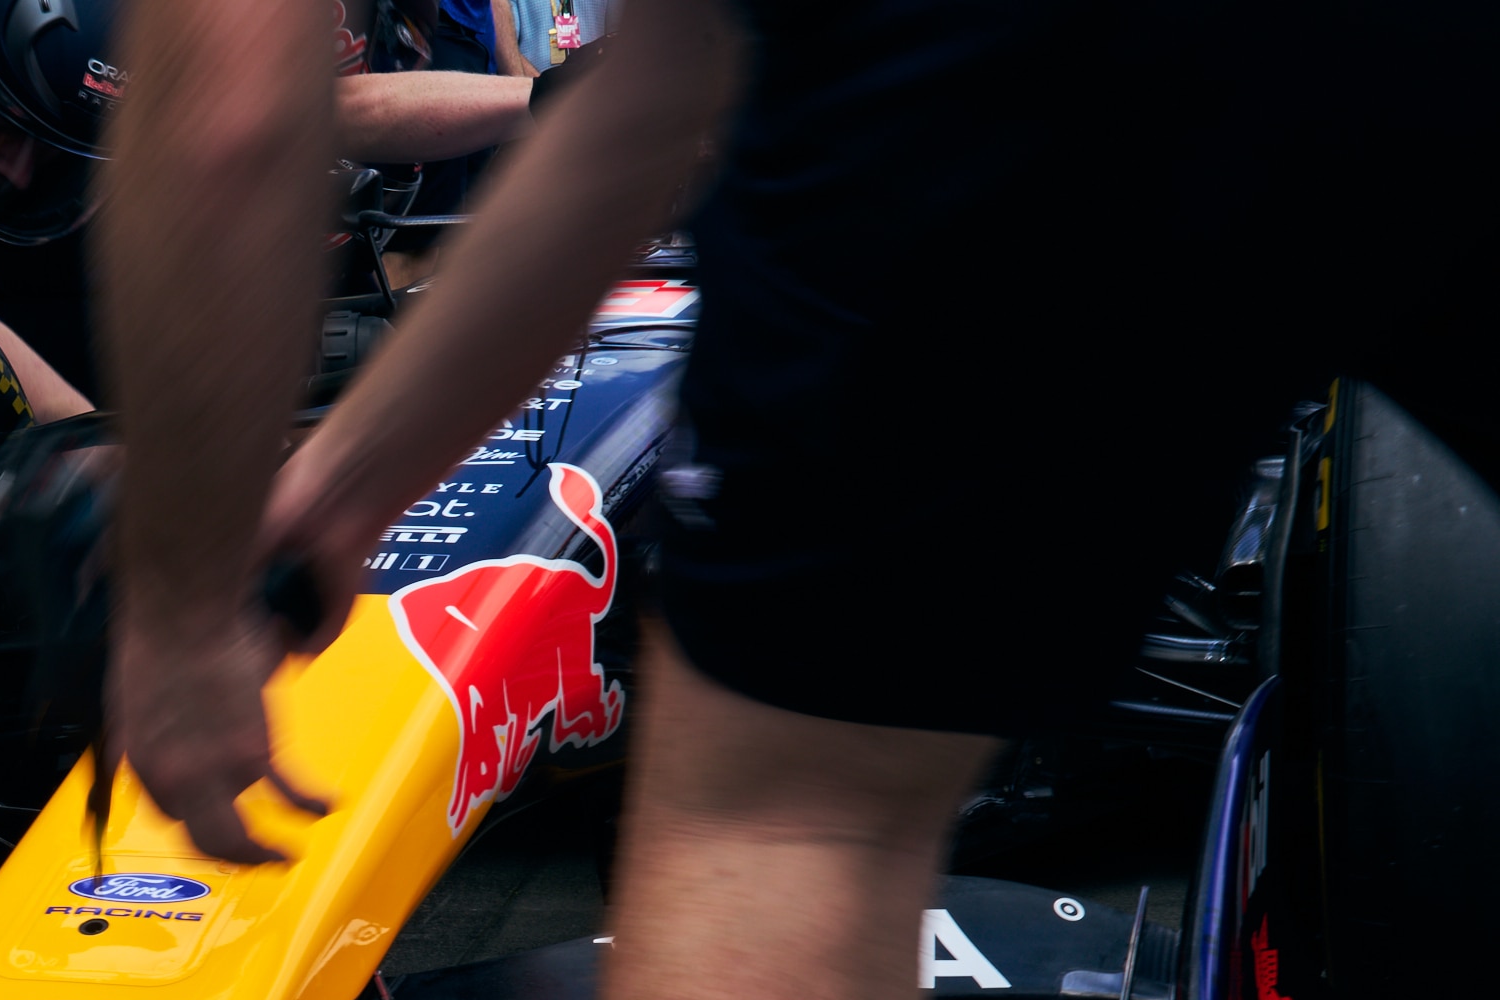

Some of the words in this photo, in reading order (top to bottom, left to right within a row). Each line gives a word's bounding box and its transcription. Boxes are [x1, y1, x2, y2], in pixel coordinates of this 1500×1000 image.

[87, 57, 132, 83] ORA
[94, 876, 183, 899] Ford
[45, 906, 204, 921] RACING
